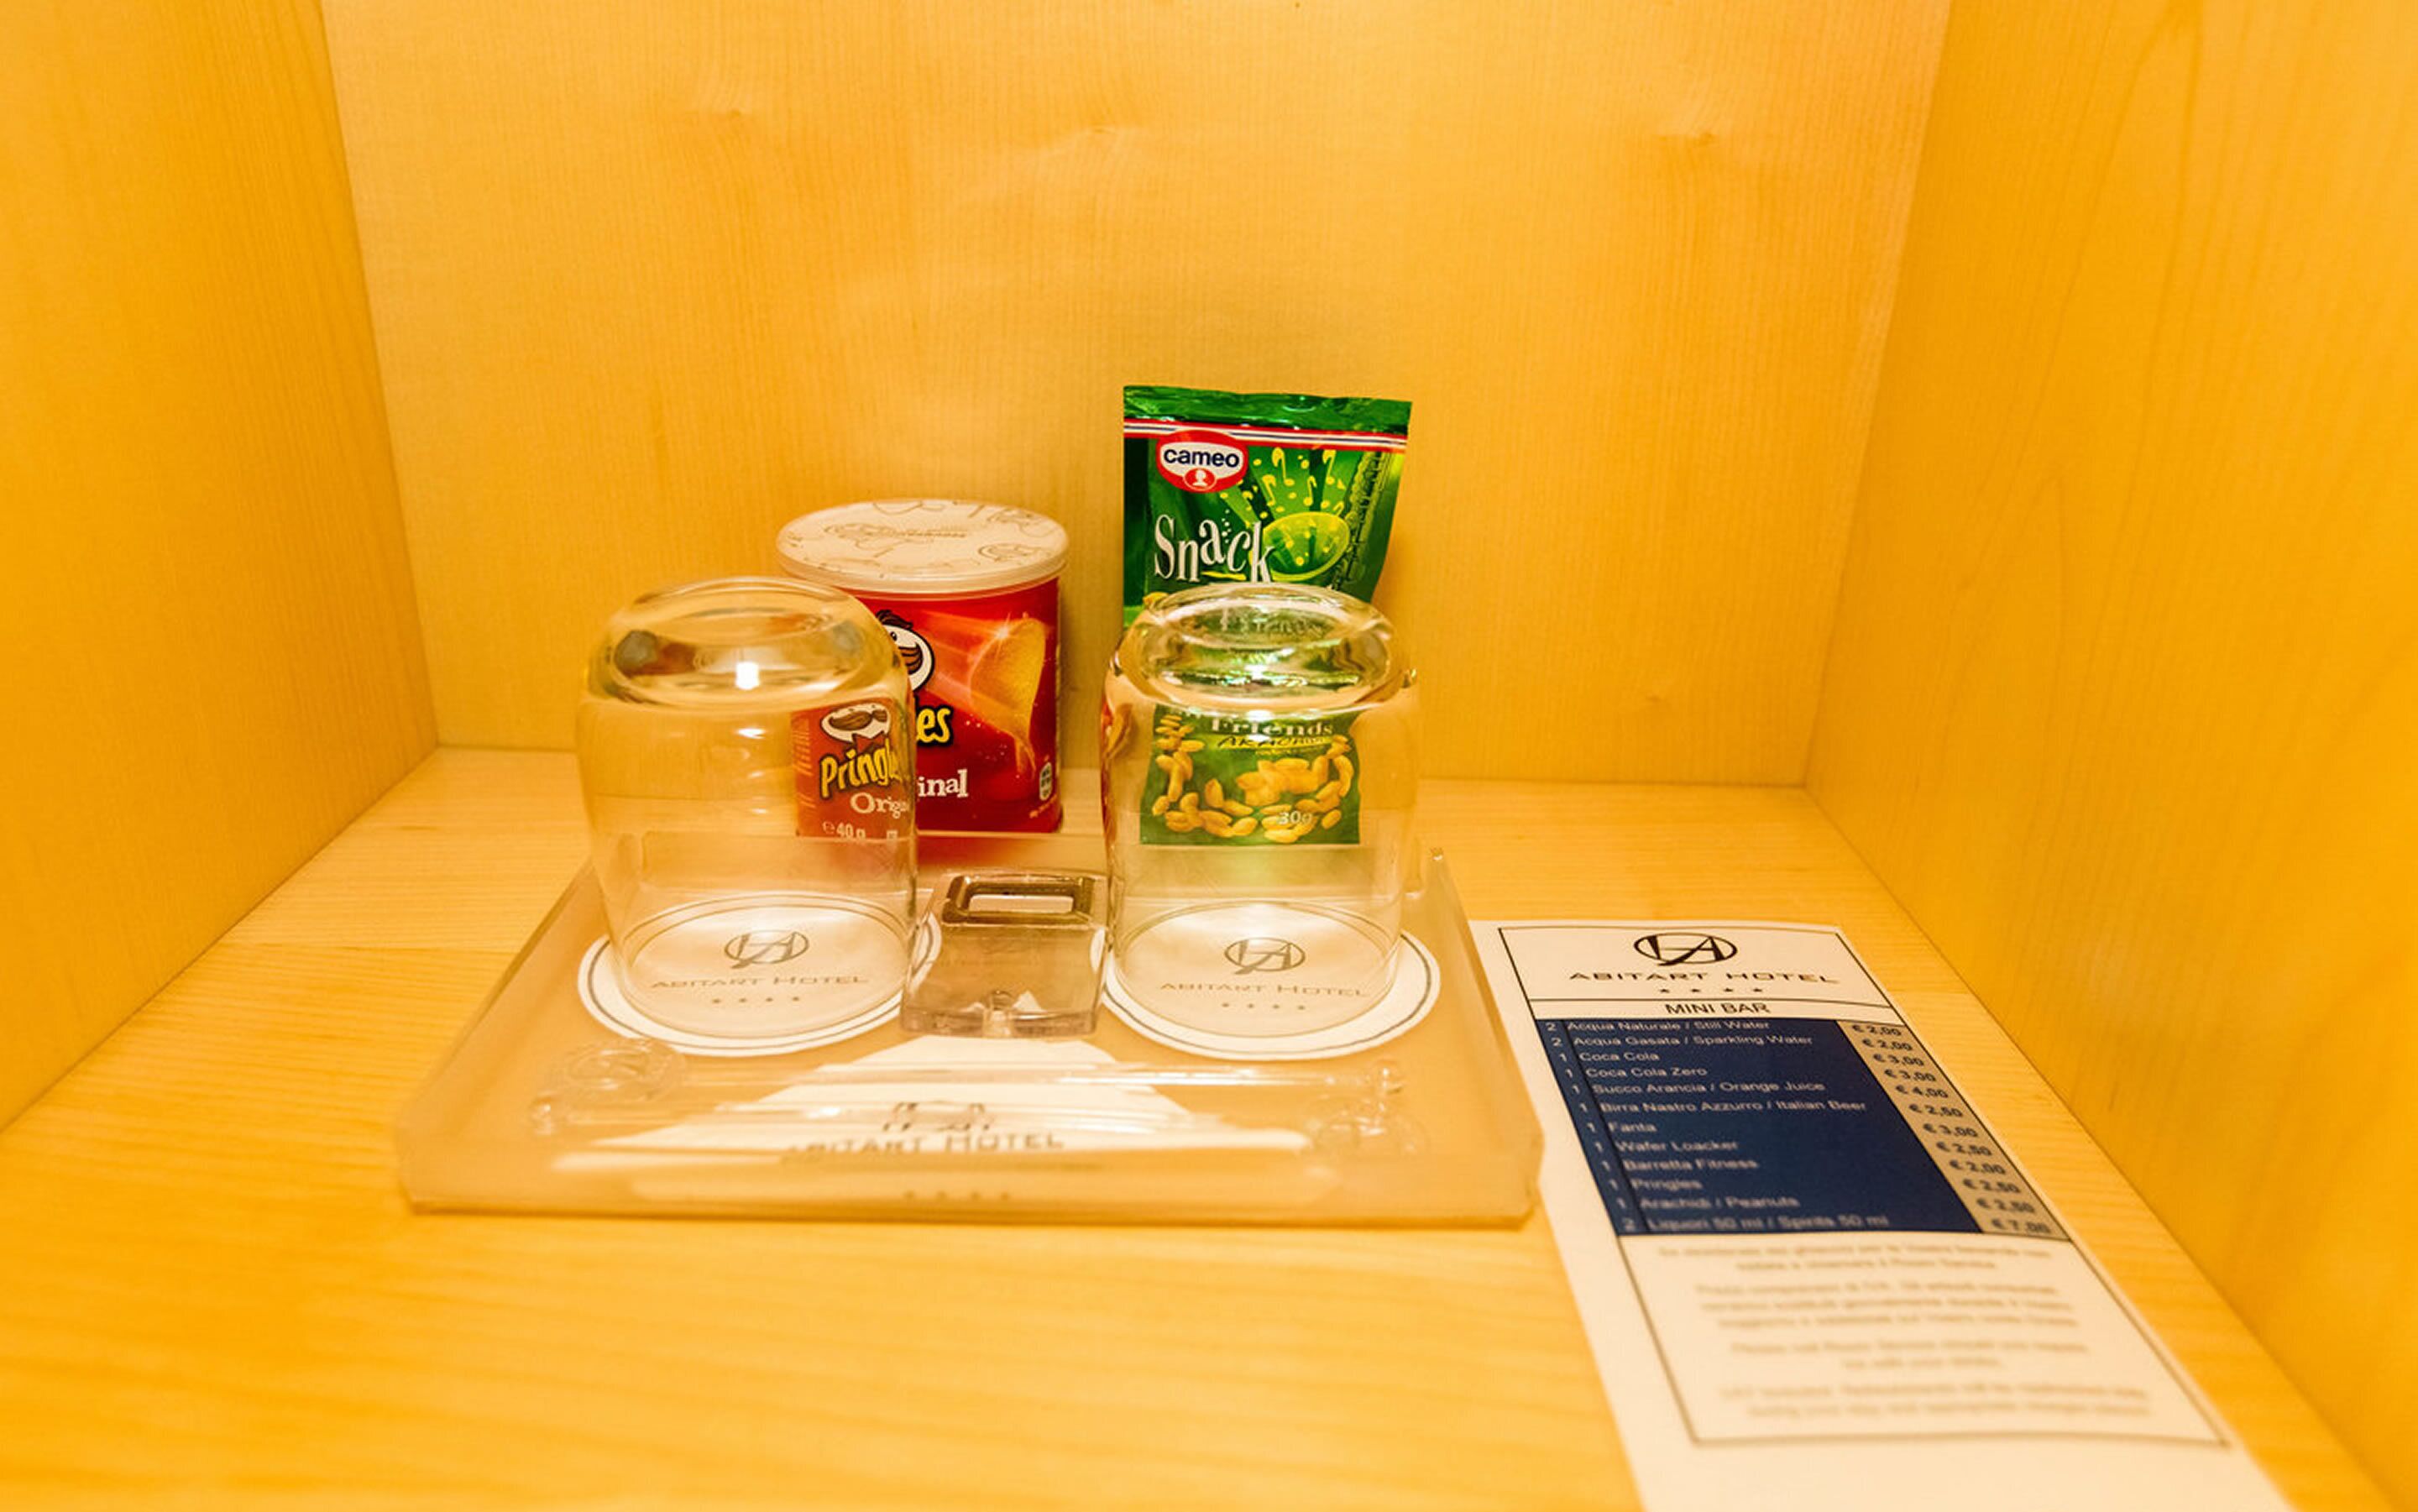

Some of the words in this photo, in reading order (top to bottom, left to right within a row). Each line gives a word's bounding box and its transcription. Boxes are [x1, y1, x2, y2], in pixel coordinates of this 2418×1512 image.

[1164, 448, 1240, 468] cameo
[1154, 515, 1274, 583] Snack
[1568, 971, 1709, 982] ABITART
[1725, 971, 1841, 984] HOTEL
[1665, 1002, 1715, 1015] MINI
[1721, 1002, 1771, 1015] BAR
[1546, 1022, 1557, 1032] 2
[1567, 1022, 1615, 1033] Acqua
[1618, 1021, 1681, 1031] Naturale
[1693, 1020, 1721, 1030] Still
[1725, 1020, 1770, 1030] Water
[1551, 1038, 1563, 1048] 2
[1573, 1037, 1622, 1048] Acqua
[1625, 1036, 1681, 1046] Gasata
[1693, 1035, 1765, 1046] Sparkling
[1766, 1035, 1813, 1045] Water
[1578, 1052, 1620, 1061] Coca
[1624, 1051, 1661, 1061] Cola
[1585, 1068, 1628, 1078] Coca
[1630, 1067, 1667, 1077] Cola
[1672, 1066, 1709, 1076] Zero
[1592, 1084, 1643, 1093] Succo
[1646, 1082, 1707, 1092] Arancia
[1719, 1081, 1780, 1093] Orange
[1782, 1080, 1826, 1091] Juice
[1599, 1102, 1640, 1112] Birra
[1642, 1101, 1697, 1112] Nastro
[1701, 1101, 1763, 1112] Azzurro
[1776, 1100, 1826, 1111] Italian
[1827, 1100, 1867, 1111] Beer
[1608, 1122, 1658, 1133] Fanta
[1614, 1141, 1668, 1152] Wafer
